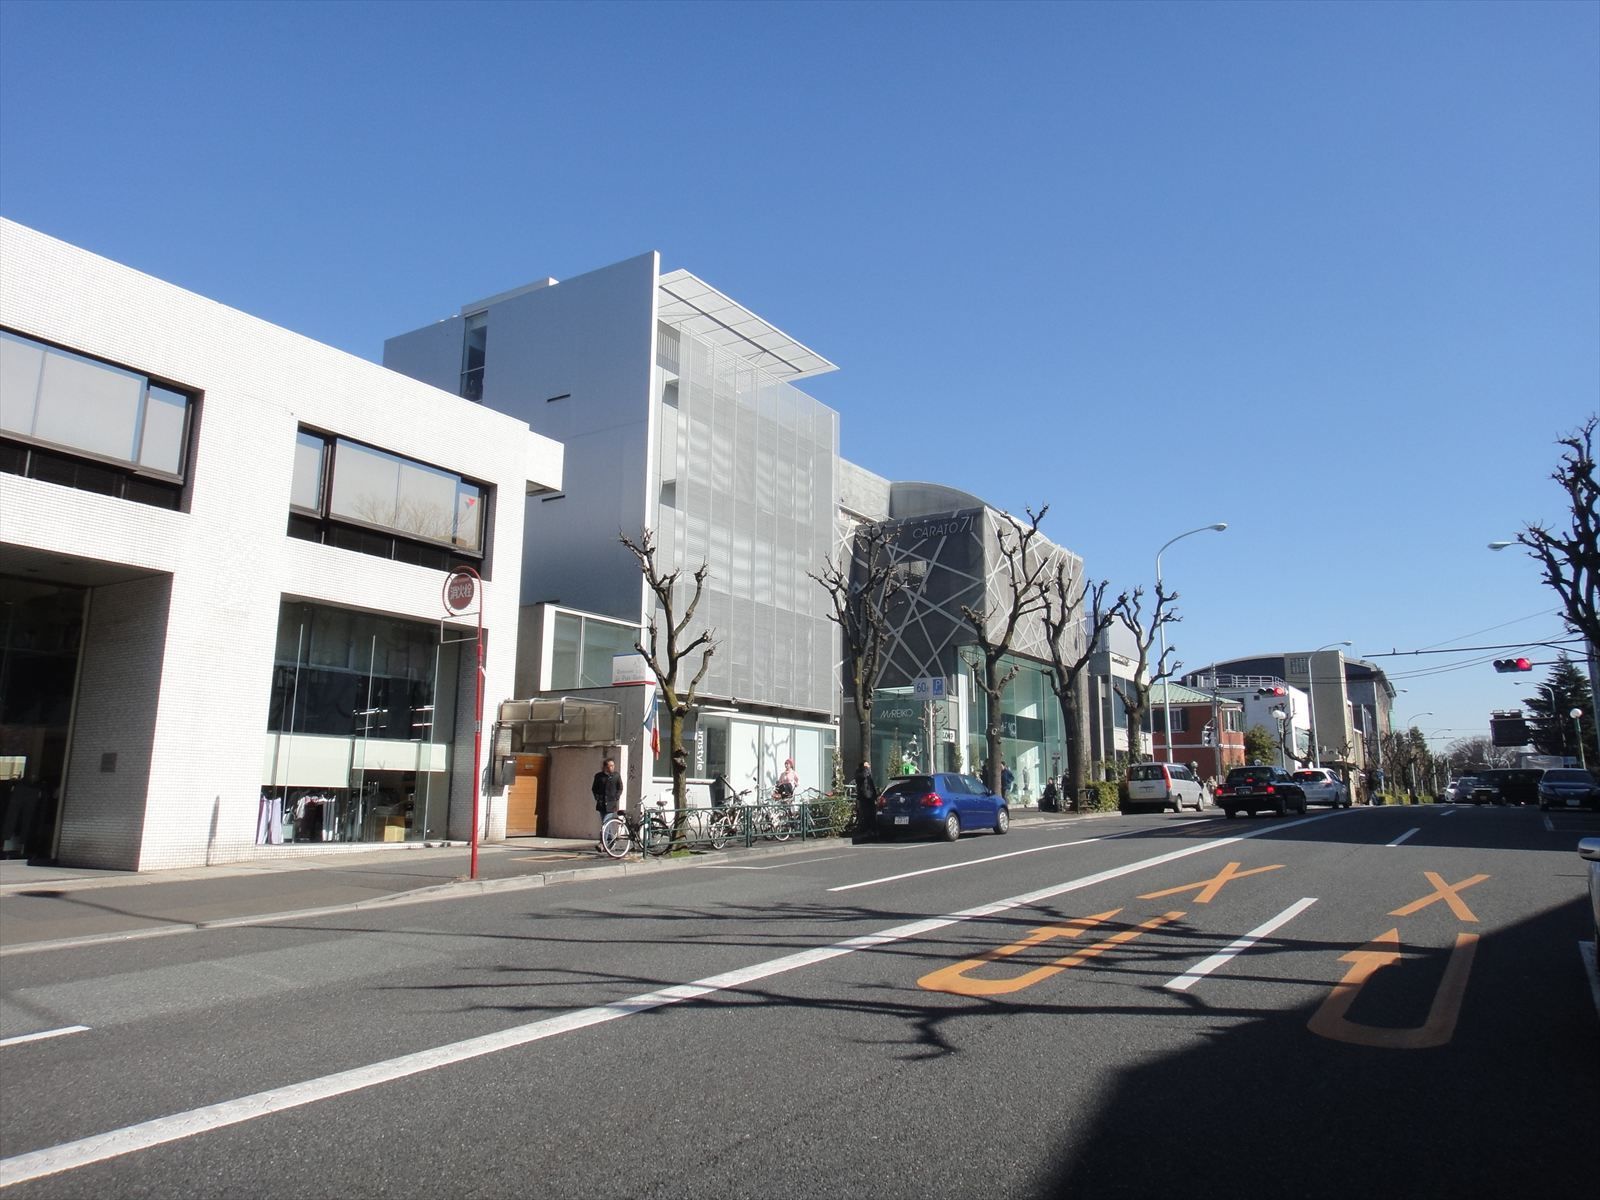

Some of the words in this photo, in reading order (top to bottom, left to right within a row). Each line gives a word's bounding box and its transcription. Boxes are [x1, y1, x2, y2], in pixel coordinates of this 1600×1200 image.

[912, 523, 959, 539] CARATO
[960, 514, 974, 533] 71
[450, 583, 473, 599] 消火栓
